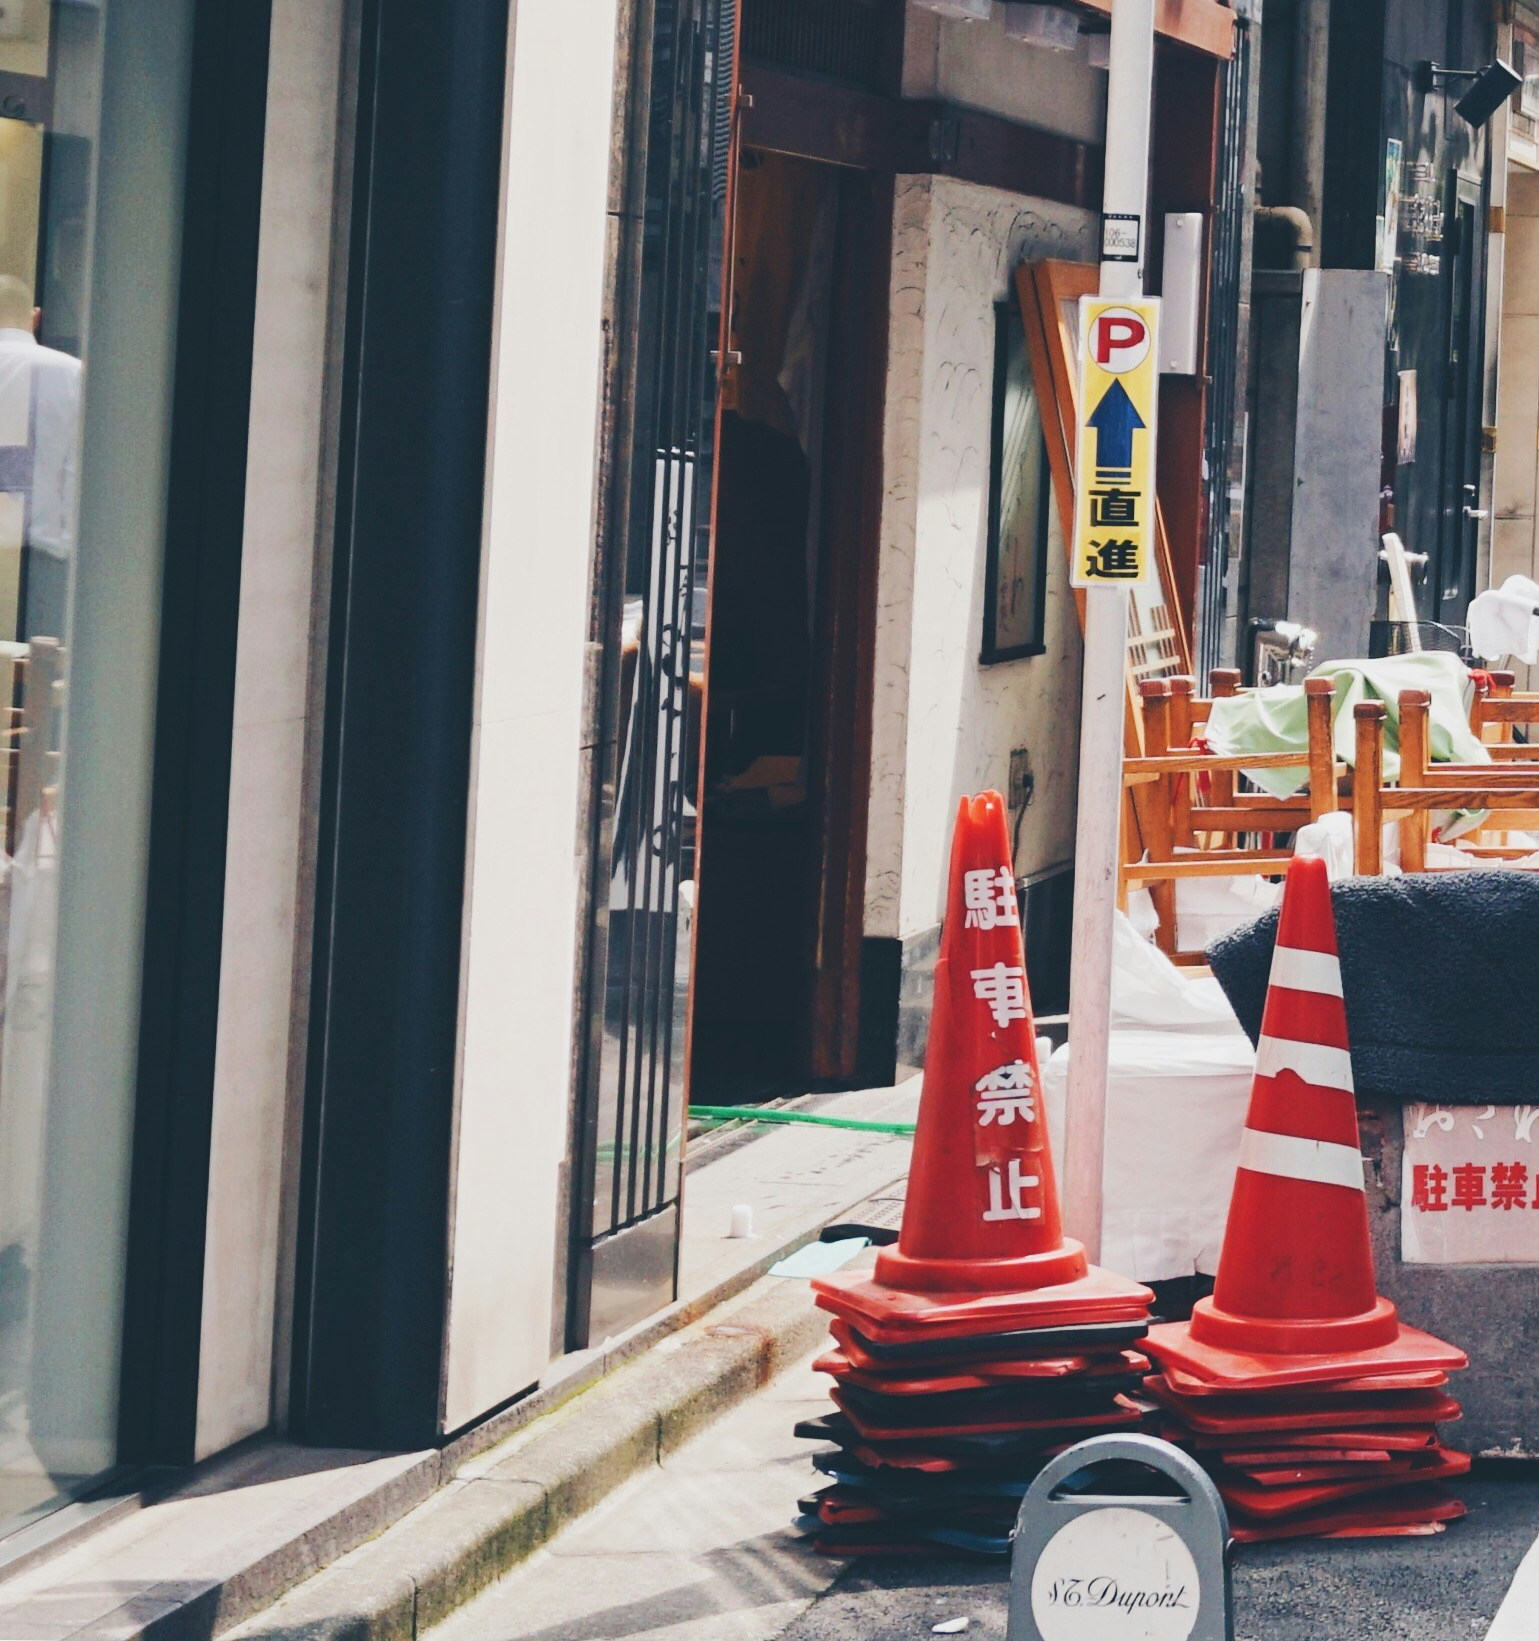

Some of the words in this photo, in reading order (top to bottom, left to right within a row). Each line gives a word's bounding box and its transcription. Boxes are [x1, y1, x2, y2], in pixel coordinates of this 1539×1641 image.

[1096, 316, 1145, 364] P
[1085, 487, 1141, 579] 直進
[963, 865, 1041, 1223] 駐車禁止
[1087, 1576, 1191, 1615] Dupont
